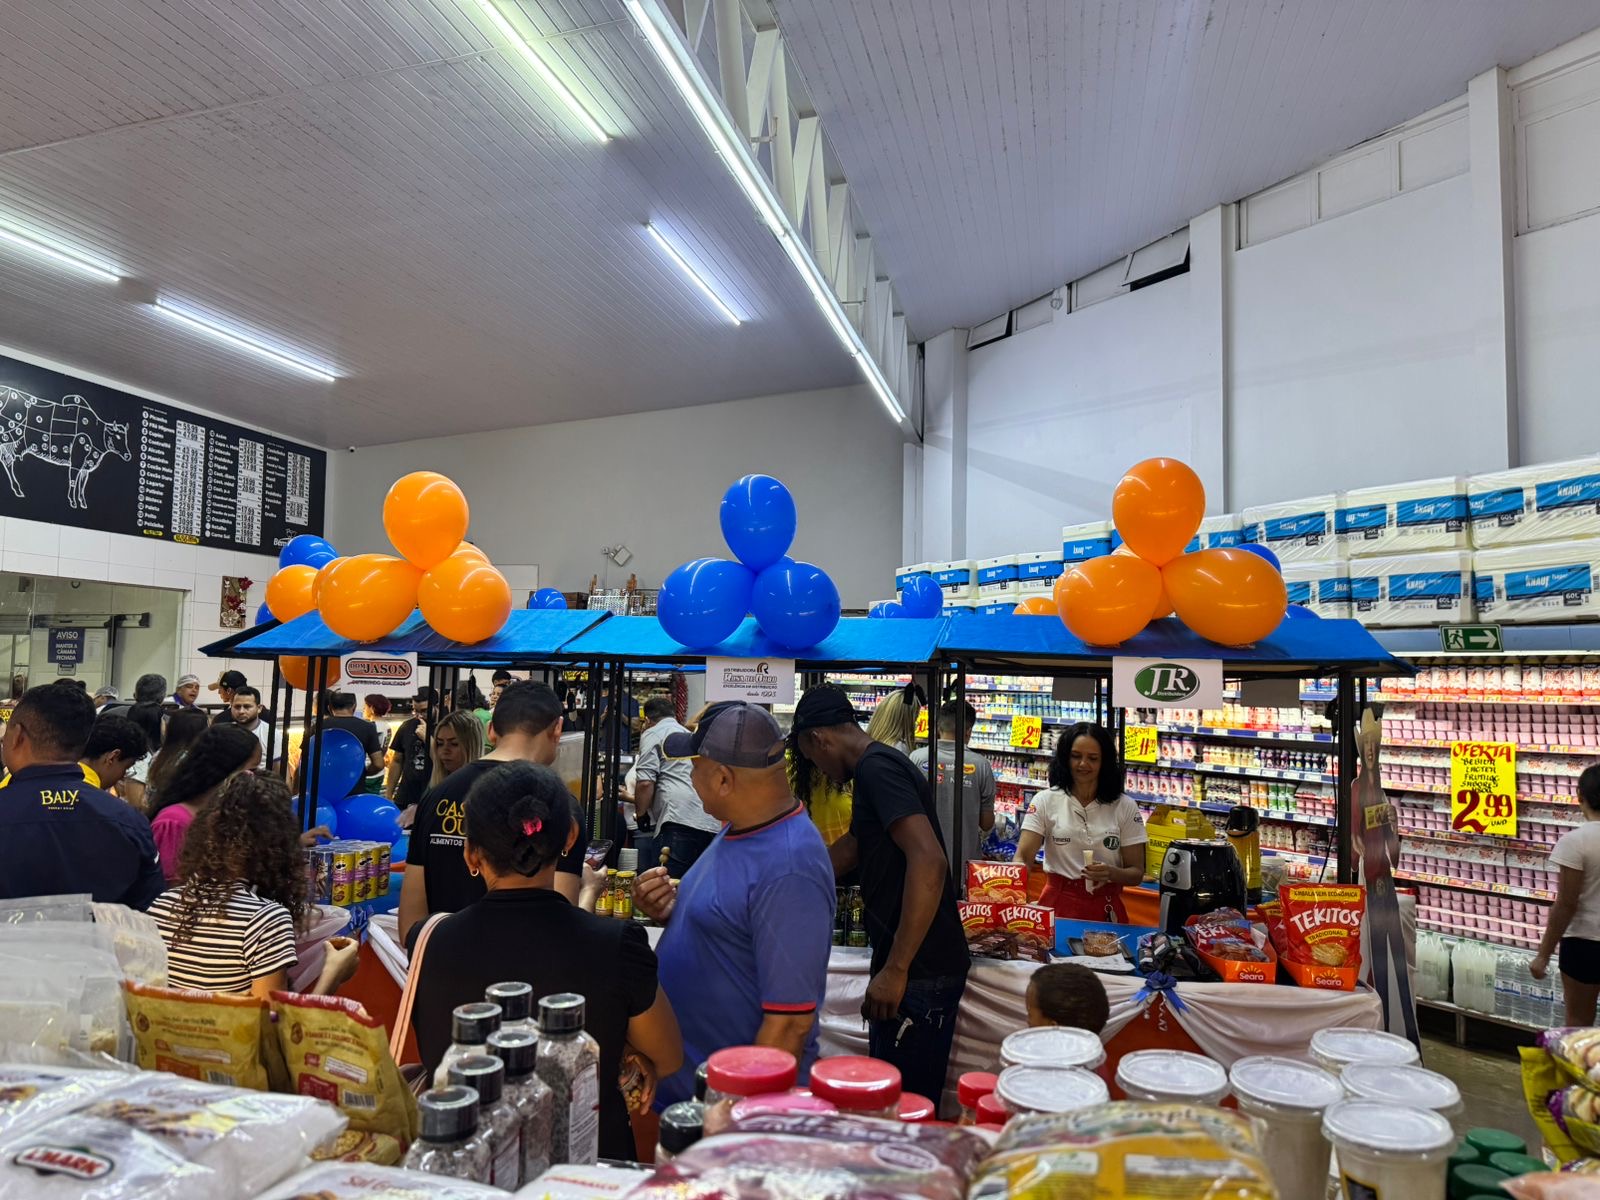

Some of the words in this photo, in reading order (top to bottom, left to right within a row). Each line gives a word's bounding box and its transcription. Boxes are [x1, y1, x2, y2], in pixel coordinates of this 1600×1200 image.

[1470, 500, 1484, 510] NAUF
[1526, 575, 1549, 588] KNAUF
[364, 663, 407, 674] JASON
[1150, 668, 1190, 695] JR
[1452, 742, 1512, 763] OFERTA
[40, 790, 79, 805] BALY
[436, 799, 465, 818] CAS
[442, 816, 466, 835] OU
[430, 838, 463, 846] ALIMENTOS
[973, 865, 1021, 883] TEKITOS
[959, 904, 992, 921] EKITOS
[998, 906, 1043, 923] TEKITOS
[1290, 908, 1360, 933] TEKITOS
[1309, 931, 1343, 941] TRADICIONAL
[1240, 972, 1264, 981] Seara
[1316, 977, 1341, 986] Seara
